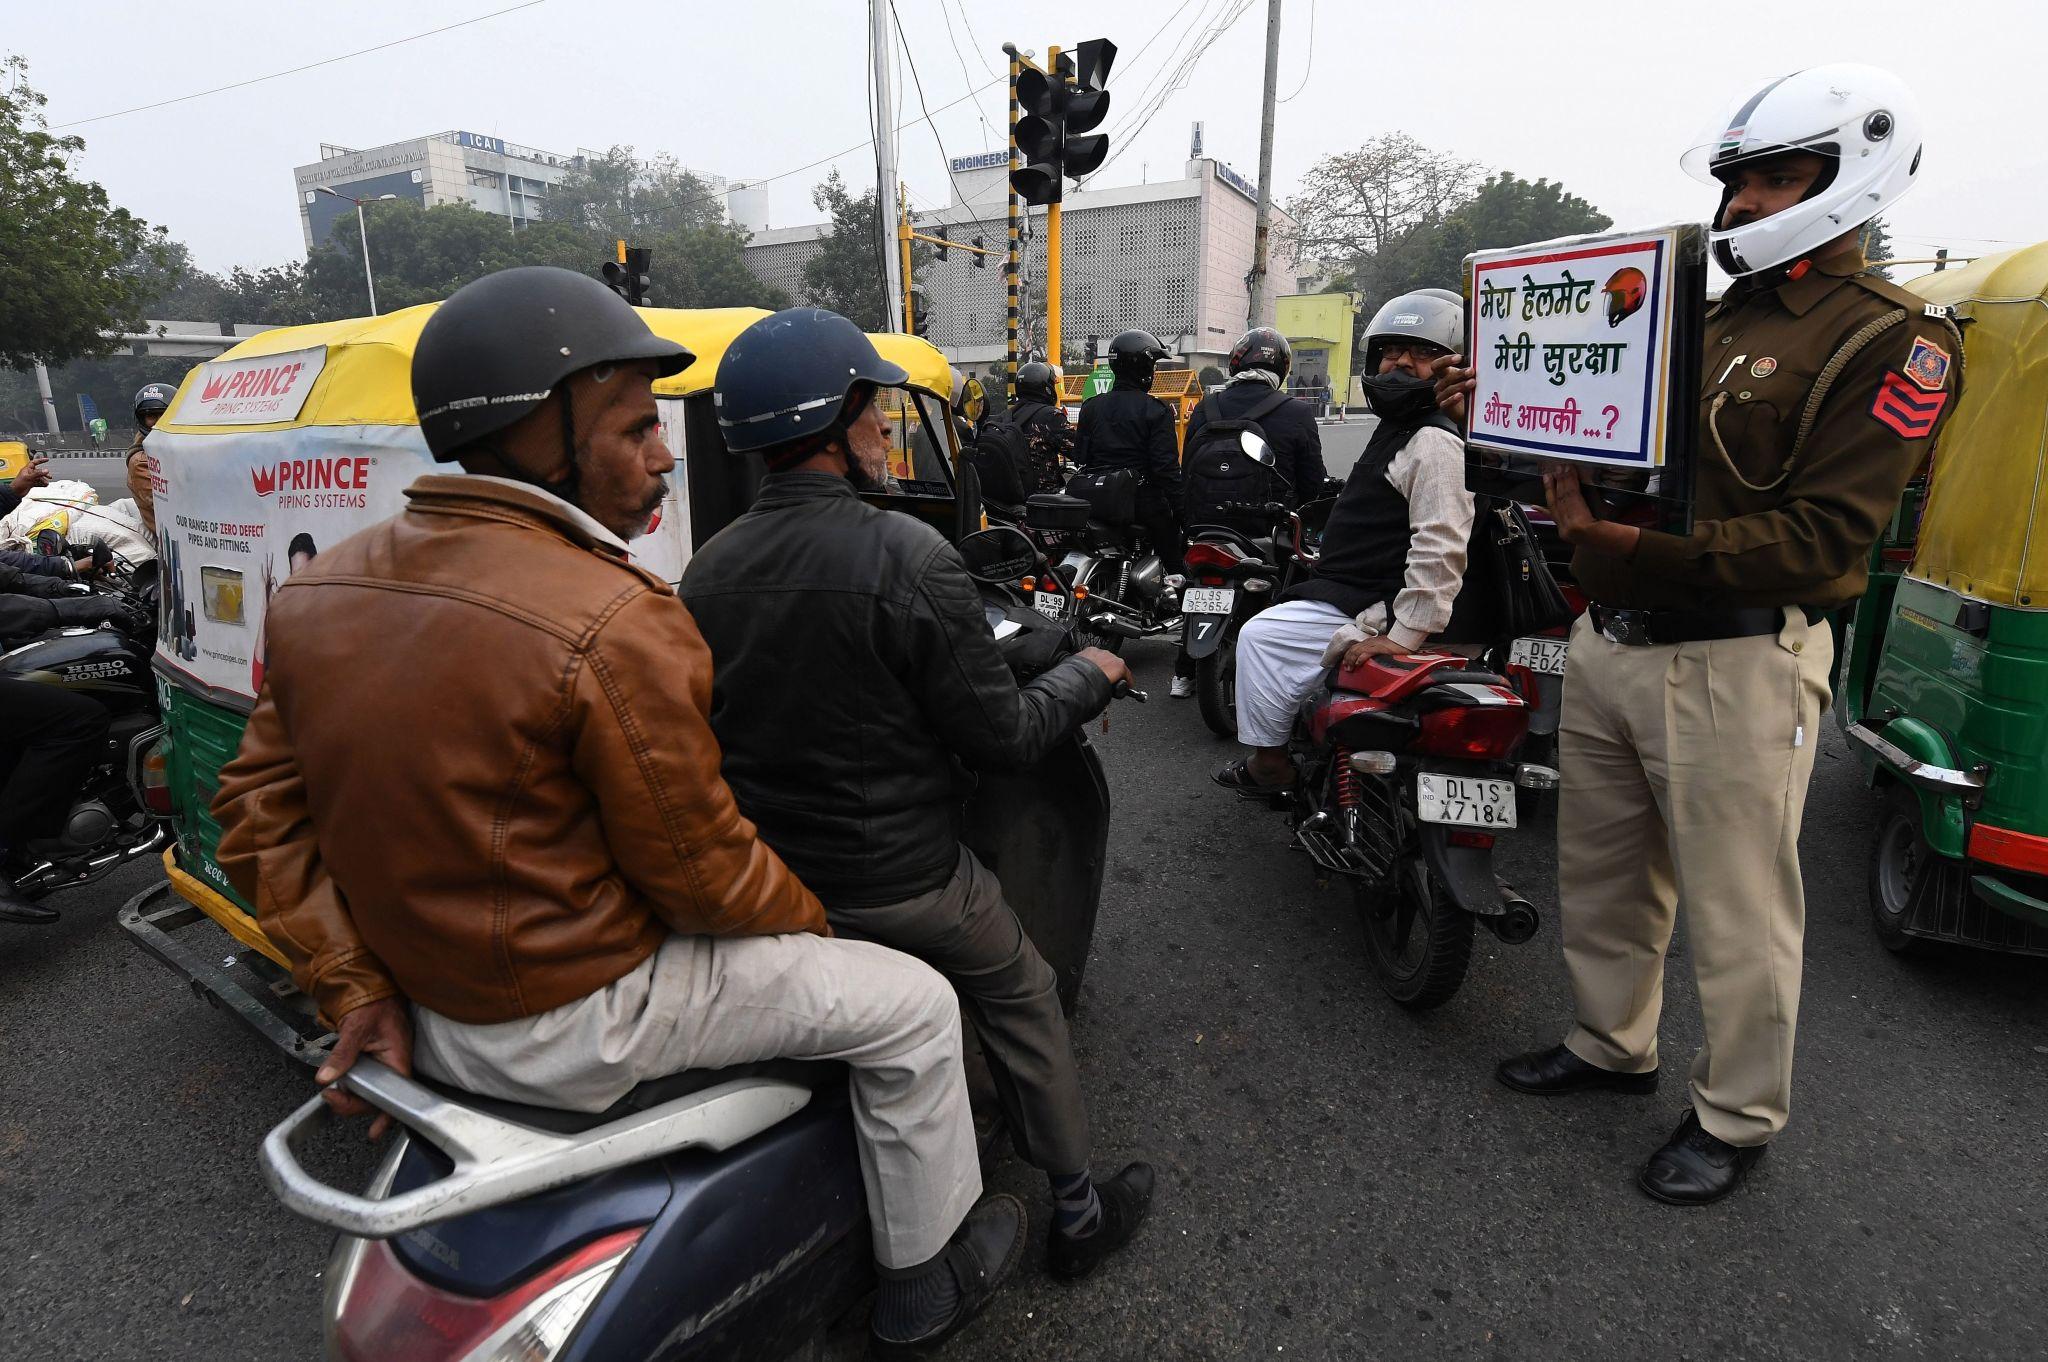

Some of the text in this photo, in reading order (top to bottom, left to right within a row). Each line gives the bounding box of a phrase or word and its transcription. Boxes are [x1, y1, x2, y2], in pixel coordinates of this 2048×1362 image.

[470, 133, 497, 150] ICAI
[952, 151, 1009, 171] ENGINEERS
[1480, 269, 1595, 322] मेरा हेलमेट
[1494, 331, 1627, 386] मेरी सुरक्षा
[223, 362, 301, 399] PRINCE
[1093, 378, 1113, 395] W
[212, 398, 280, 415] PIPING SYSTEMS
[1484, 391, 1513, 429] और
[278, 457, 370, 492] PRINCE
[278, 493, 366, 510] PIPING SYSTEMS
[176, 514, 188, 528] OUR
[188, 518, 209, 533] RANGE
[210, 522, 219, 534] OF
[220, 523, 237, 536] ZERO
[188, 532, 252, 554] PIPES AND FITTINGS.
[1197, 622, 1213, 640] 7
[62, 667, 133, 683] HONDA
[67, 660, 125, 675] HERO
[1446, 779, 1500, 804] DL1S
[1441, 800, 1509, 824] X7184
